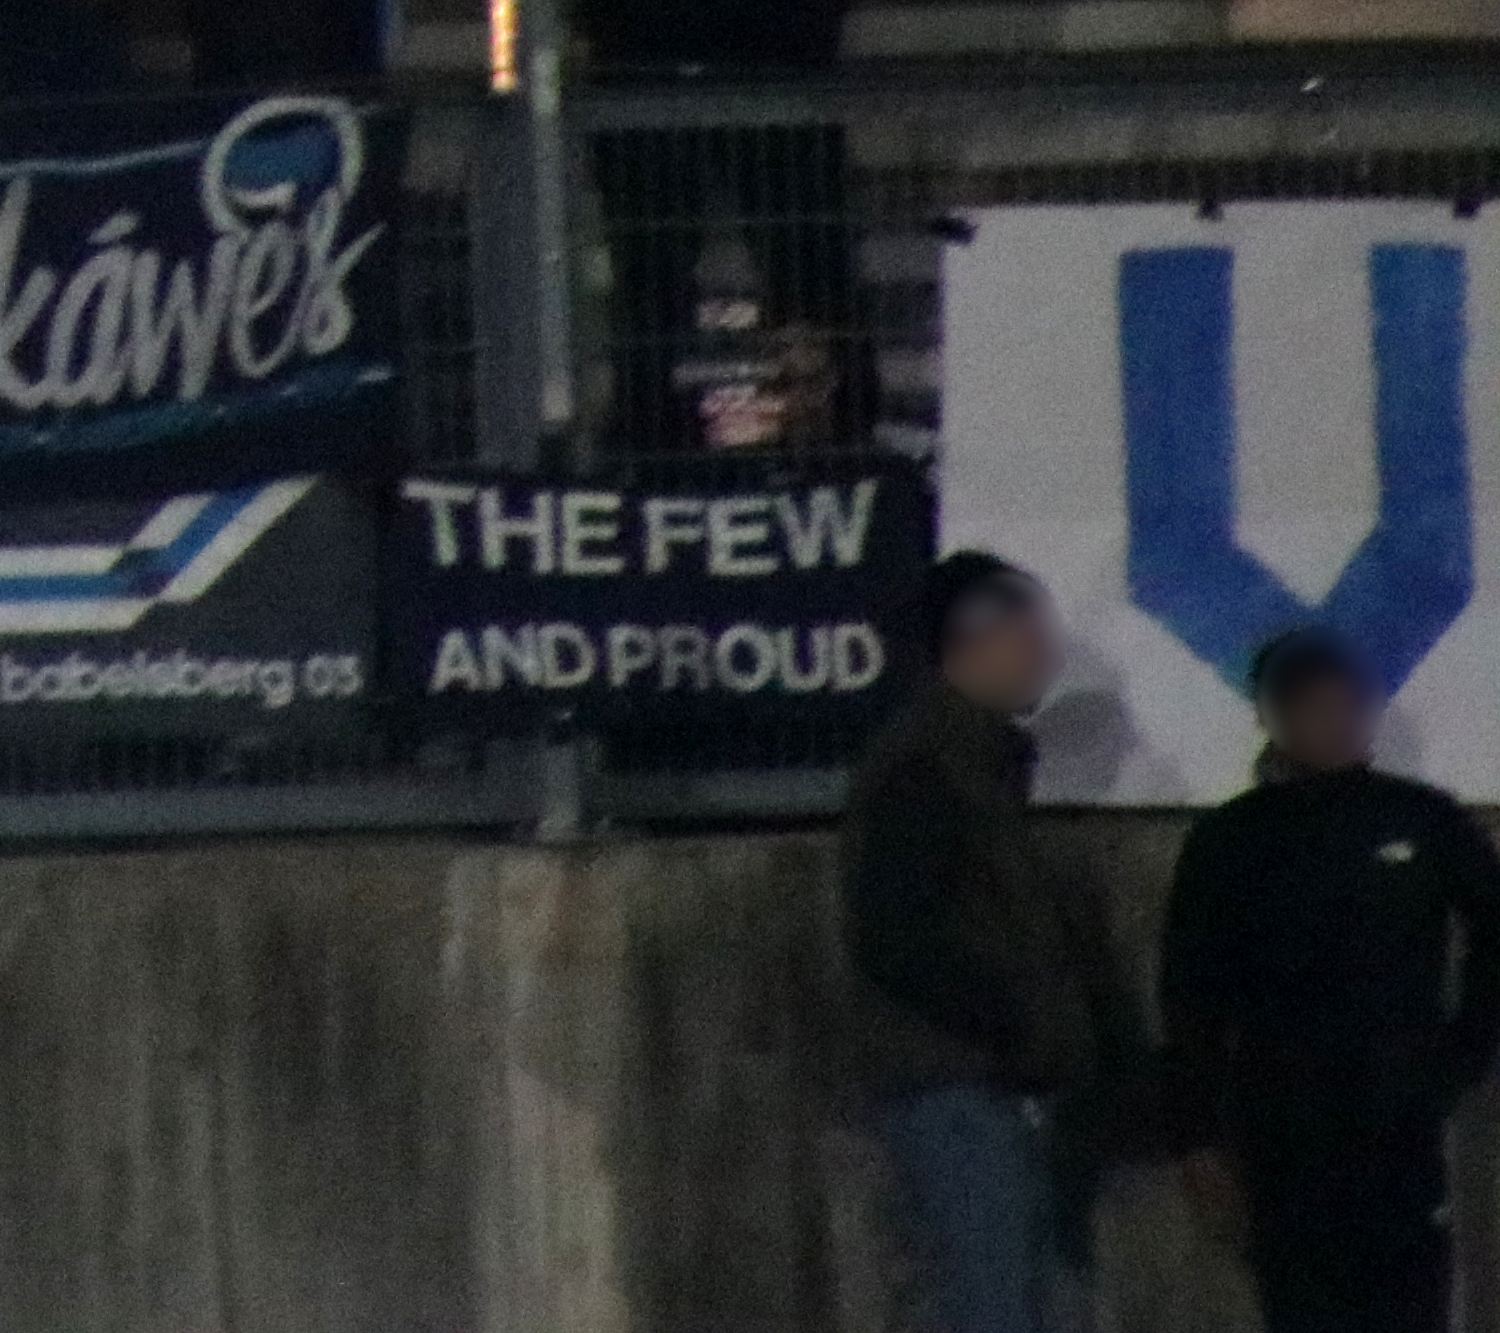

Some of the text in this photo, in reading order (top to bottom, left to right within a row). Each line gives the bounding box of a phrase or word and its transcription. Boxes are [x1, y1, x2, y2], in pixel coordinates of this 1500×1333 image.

[400, 476, 879, 579] THE FEW
[304, 652, 362, 697] 03
[427, 619, 886, 696] AND PROUD
